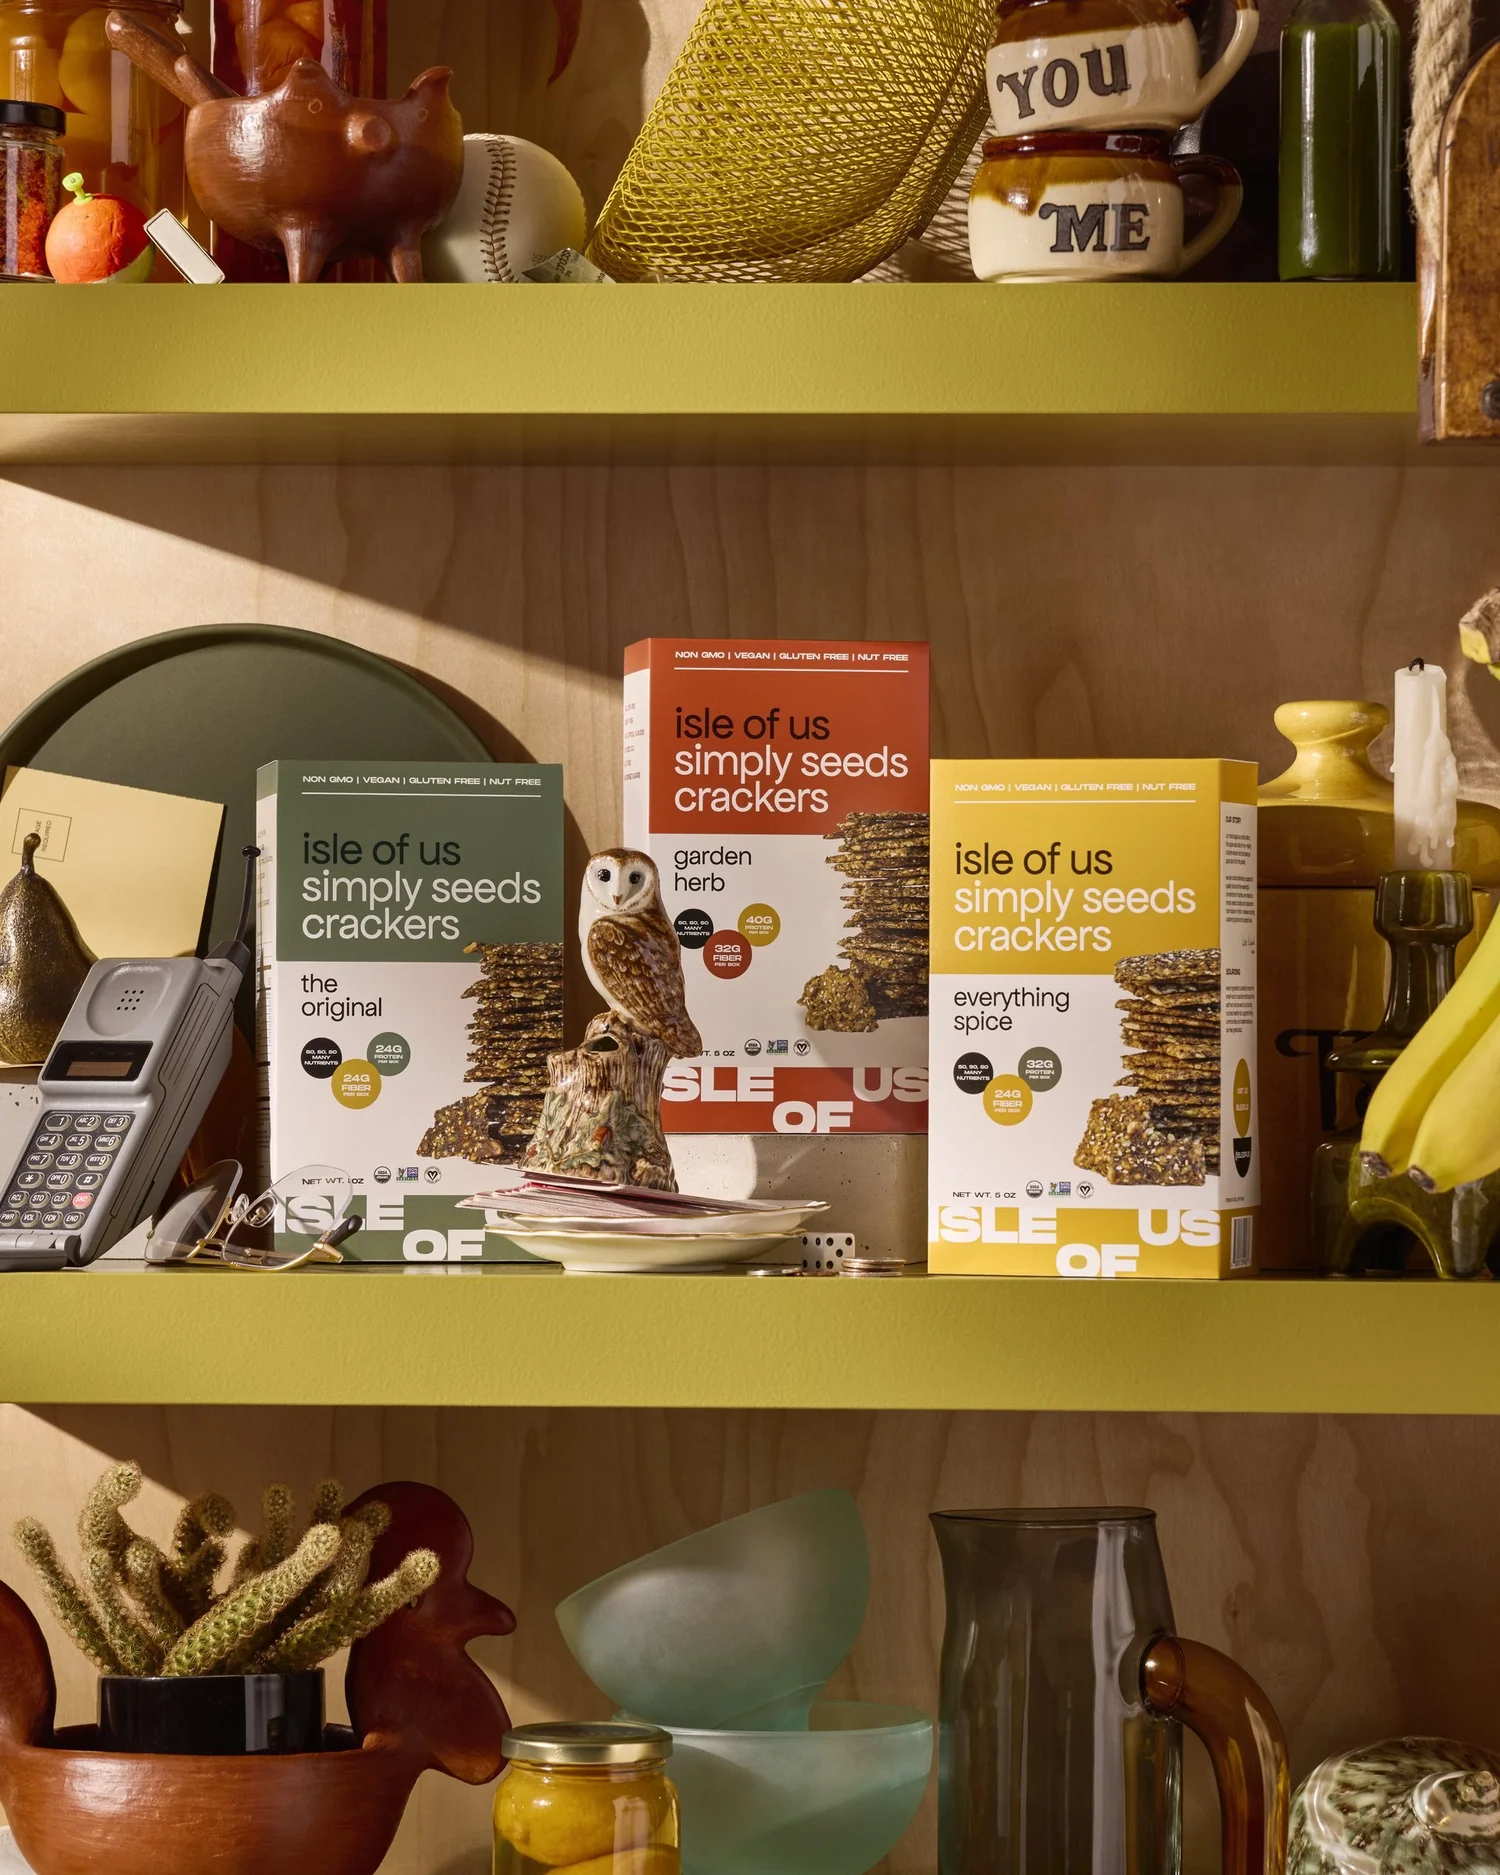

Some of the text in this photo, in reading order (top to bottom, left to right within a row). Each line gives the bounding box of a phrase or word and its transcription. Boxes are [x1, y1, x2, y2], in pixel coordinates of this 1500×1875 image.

[996, 45, 1131, 119] YOU
[1039, 202, 1151, 253] ME
[734, 652, 770, 660] VEGAN
[823, 653, 849, 661] FREE
[676, 707, 830, 740] isle of us
[674, 743, 908, 785] simply seeds
[674, 780, 829, 813] crackers
[981, 783, 1005, 791] GMO
[1014, 783, 1052, 791] VEGAN
[1061, 783, 1104, 791] GLUTEN
[1107, 783, 1133, 791] FREE
[1142, 783, 1165, 791] NUT
[1169, 783, 1196, 791] FREE
[41, 820, 52, 851] REQUIRED
[303, 832, 461, 866] isle of us
[674, 846, 752, 869] garden
[956, 842, 1113, 875] isle of us
[302, 870, 541, 911] simply seeds
[674, 872, 725, 892] herb
[954, 880, 1075, 922] simply
[1083, 880, 1196, 914] seeds
[302, 907, 460, 940] crackers
[746, 916, 773, 924] 40G
[954, 918, 1112, 952] crackers
[713, 954, 742, 962] FIBER
[714, 944, 741, 953] 32G
[301, 974, 338, 993] the
[301, 997, 382, 1022] original
[954, 987, 1070, 1013] everything
[954, 1011, 1013, 1035] spice
[375, 1045, 402, 1053] 24G
[1026, 1060, 1054, 1069] 32G
[343, 1074, 370, 1082] 24G
[661, 1067, 929, 1102] SLE US
[995, 1089, 1021, 1098] 24G
[59, 1117, 65, 1125] 1
[87, 1117, 95, 1126] 2
[116, 1117, 124, 1127] 3
[772, 1101, 853, 1133] OF
[49, 1136, 56, 1145] 4
[78, 1136, 85, 1146] 5
[107, 1136, 116, 1146] 6
[40, 1155, 48, 1164] 7
[69, 1155, 77, 1165] 8
[99, 1156, 107, 1165] 9
[60, 1175, 68, 1184] 0
[928, 1206, 1221, 1247] ISLE US
[402, 1229, 486, 1261] OF
[1056, 1243, 1140, 1278] OF
